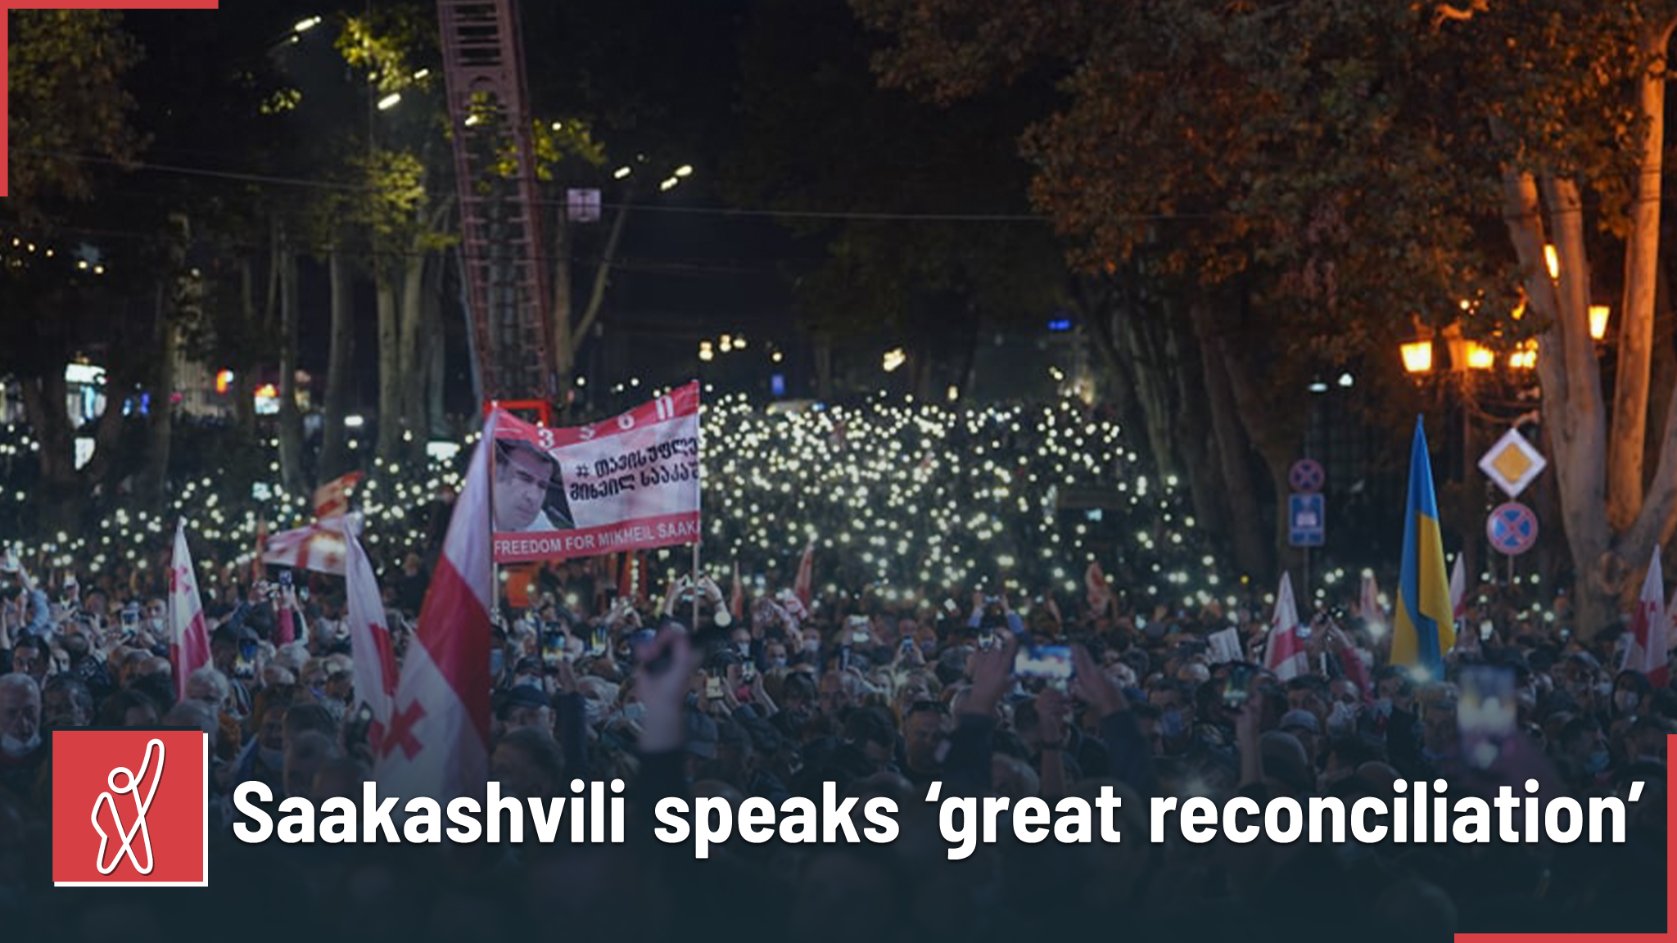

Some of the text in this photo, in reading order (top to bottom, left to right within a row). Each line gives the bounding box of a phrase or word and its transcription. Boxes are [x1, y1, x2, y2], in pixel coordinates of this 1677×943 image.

[494, 539, 561, 554] FREEDOM
[565, 534, 595, 549] FOR
[599, 528, 655, 546] MIKHEIL
